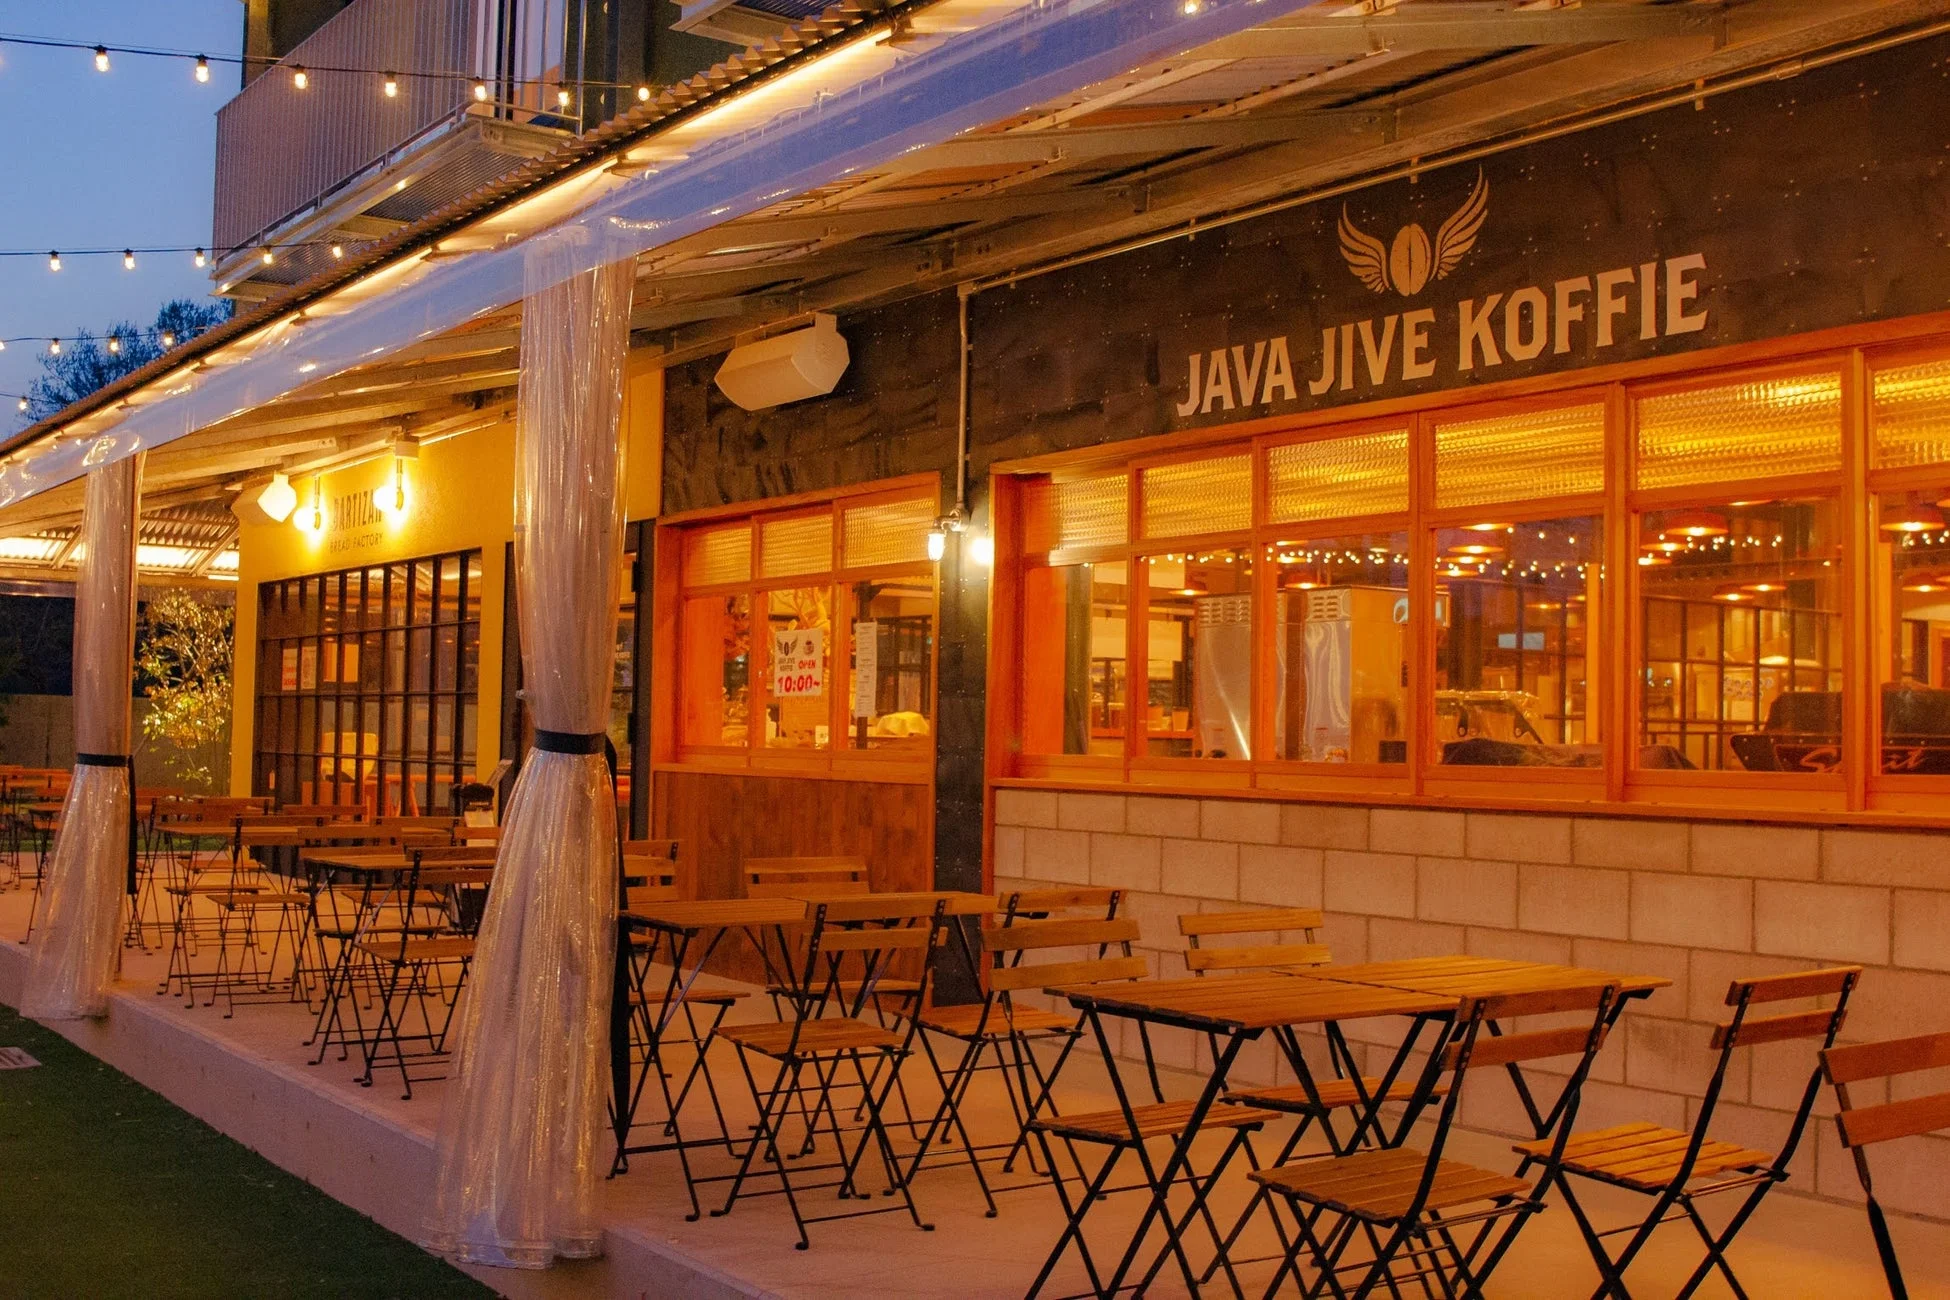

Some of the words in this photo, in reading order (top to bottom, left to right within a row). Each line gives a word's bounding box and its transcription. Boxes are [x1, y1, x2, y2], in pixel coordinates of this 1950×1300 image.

[1176, 336, 1297, 417] JAVA
[1308, 307, 1436, 396] JIVE
[1458, 252, 1709, 372] KOFFIE
[352, 532, 384, 549] FACTORY
[798, 659, 817, 670] OPEN
